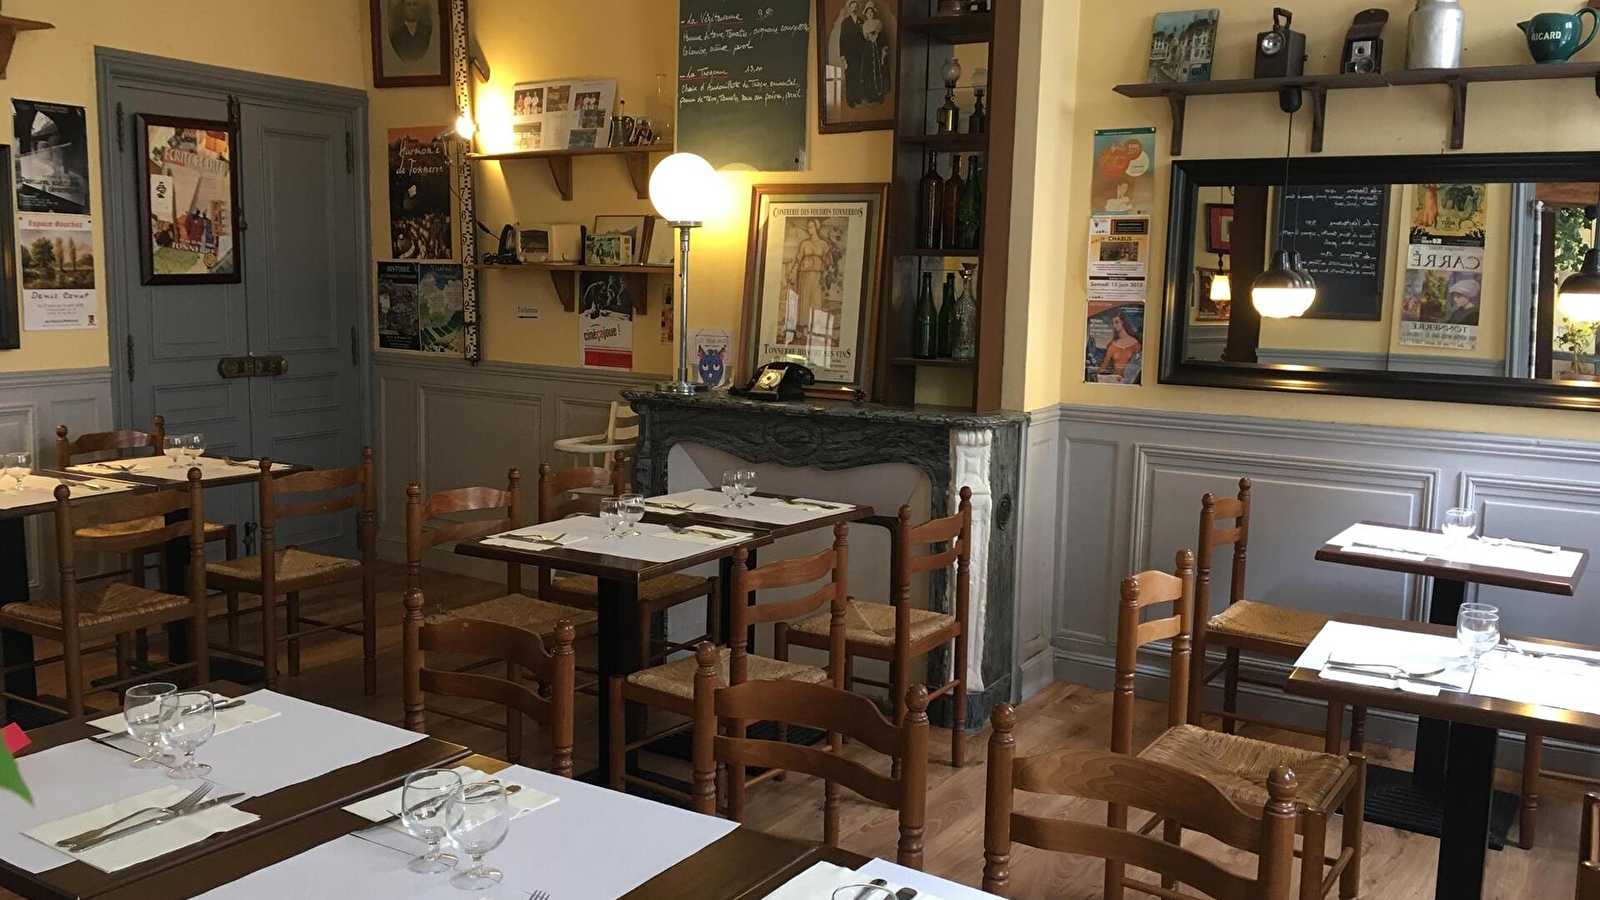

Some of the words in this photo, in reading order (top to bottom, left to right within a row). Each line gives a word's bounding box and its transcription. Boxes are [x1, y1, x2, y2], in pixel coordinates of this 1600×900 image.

[1531, 31, 1562, 41] RICARD
[773, 207, 799, 218] CONFRERIE
[800, 208, 809, 216] DES
[832, 207, 864, 218] TONNERROIS
[28, 220, 53, 228] Espace
[31, 291, 58, 299] Denis
[764, 343, 795, 355] TONNERRE
[835, 348, 851, 359] VINS
